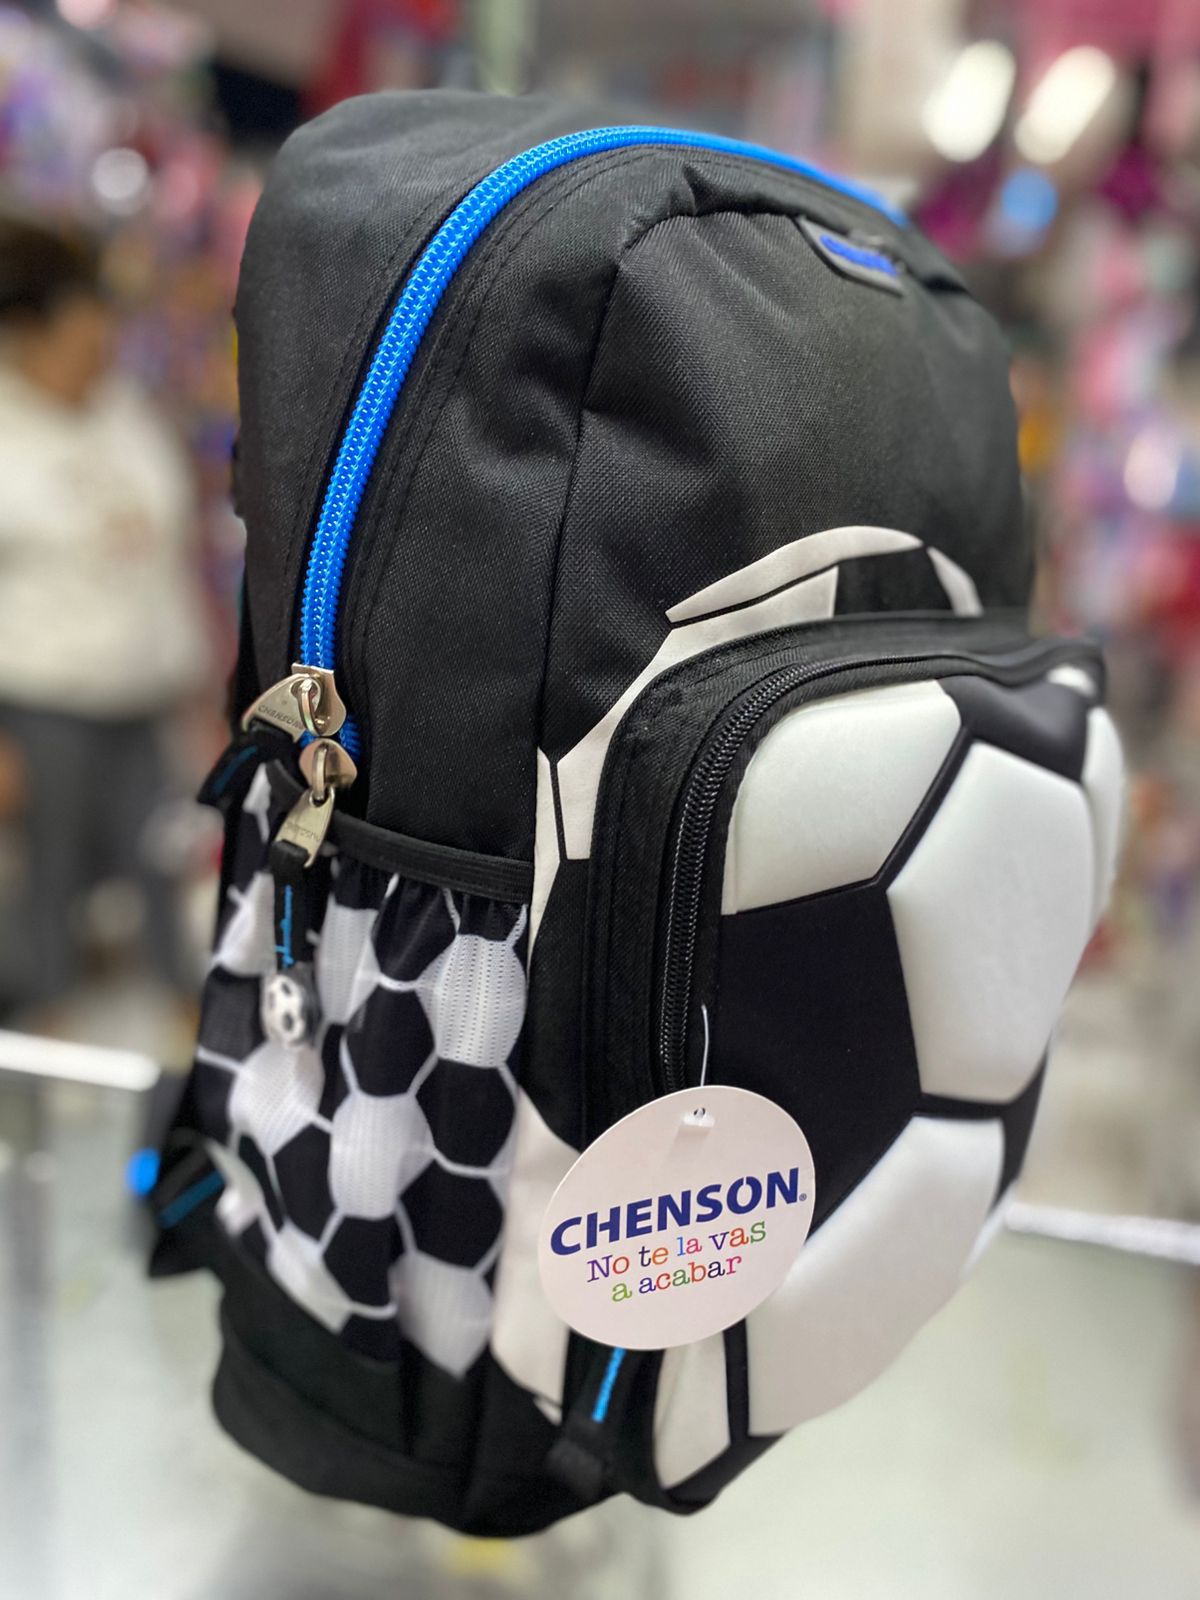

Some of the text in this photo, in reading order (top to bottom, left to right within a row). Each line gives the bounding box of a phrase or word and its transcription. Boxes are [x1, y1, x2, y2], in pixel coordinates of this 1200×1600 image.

[550, 1167, 800, 1256] CHENSON
[587, 1221, 766, 1282] No te la vas
[612, 1256, 742, 1302] a acabar
